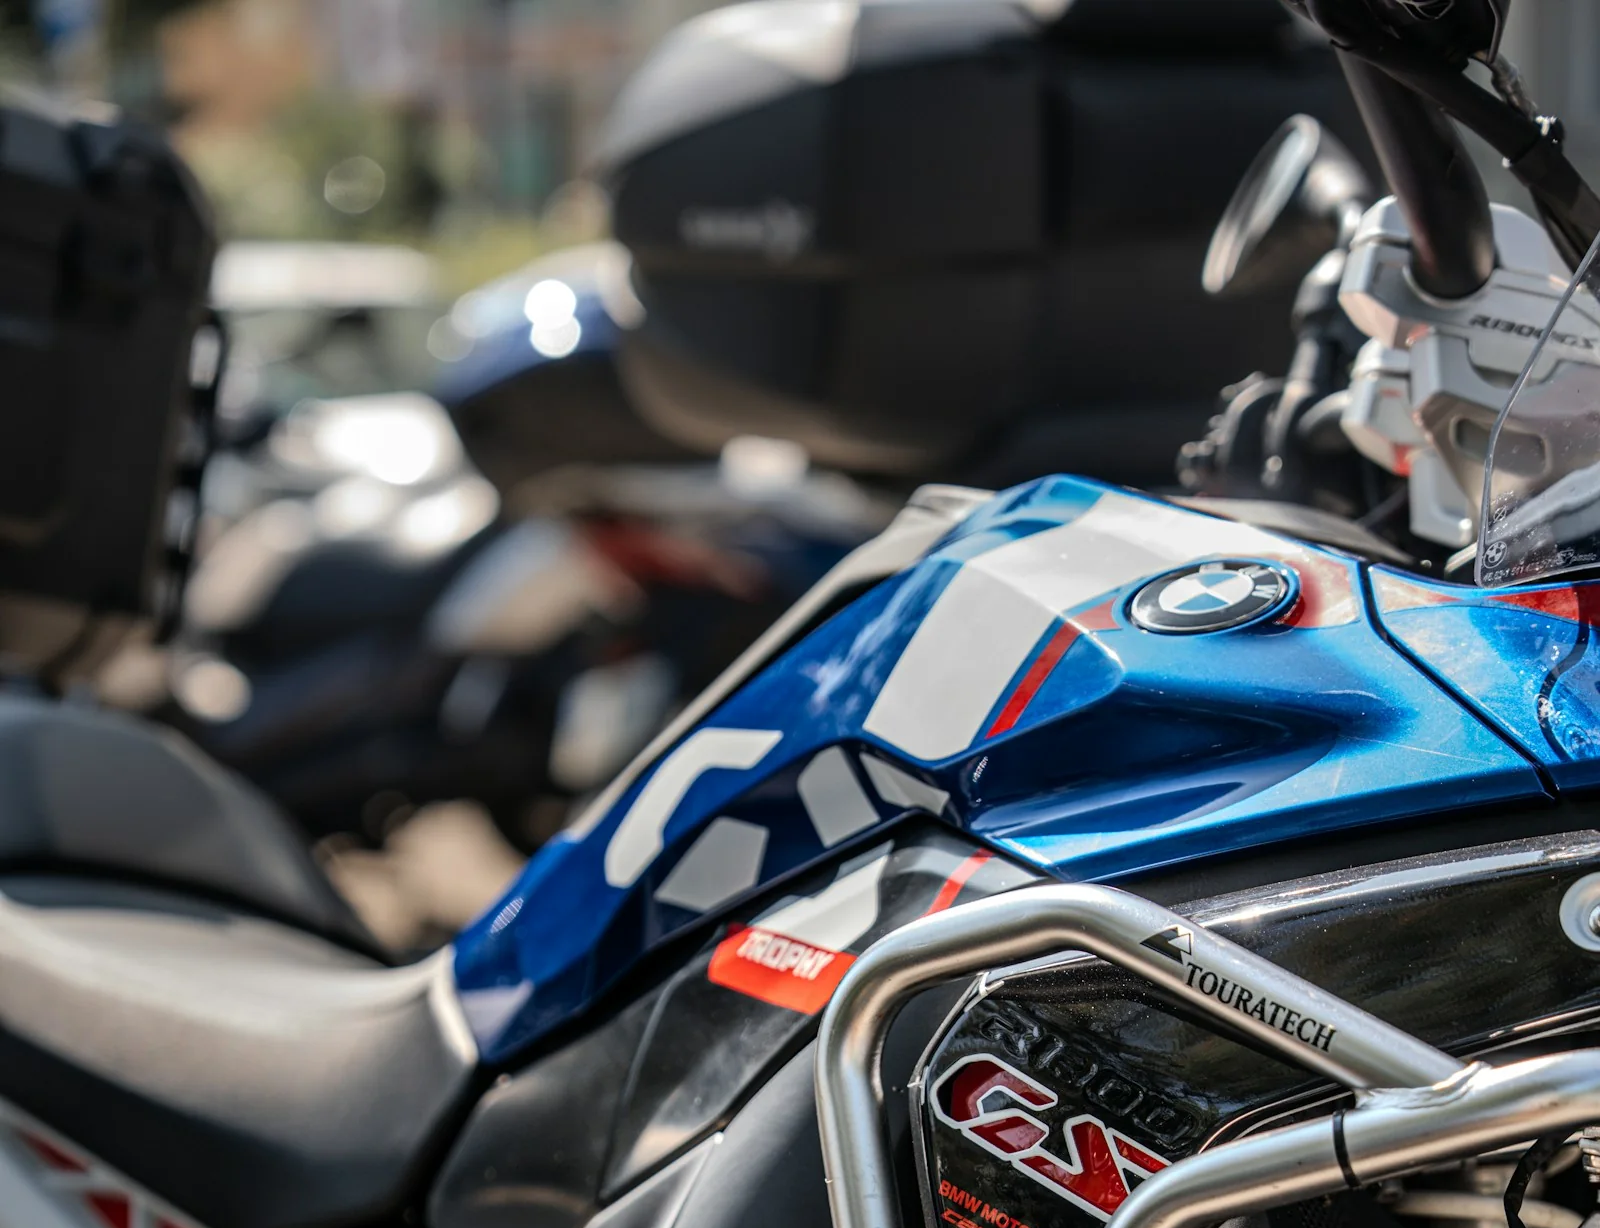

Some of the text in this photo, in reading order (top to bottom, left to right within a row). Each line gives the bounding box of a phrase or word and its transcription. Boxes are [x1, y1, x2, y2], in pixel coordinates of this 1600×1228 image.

[736, 928, 836, 981] TROPHY
[1186, 962, 1338, 1053] TOURATECH
[938, 1178, 983, 1214] BMW
